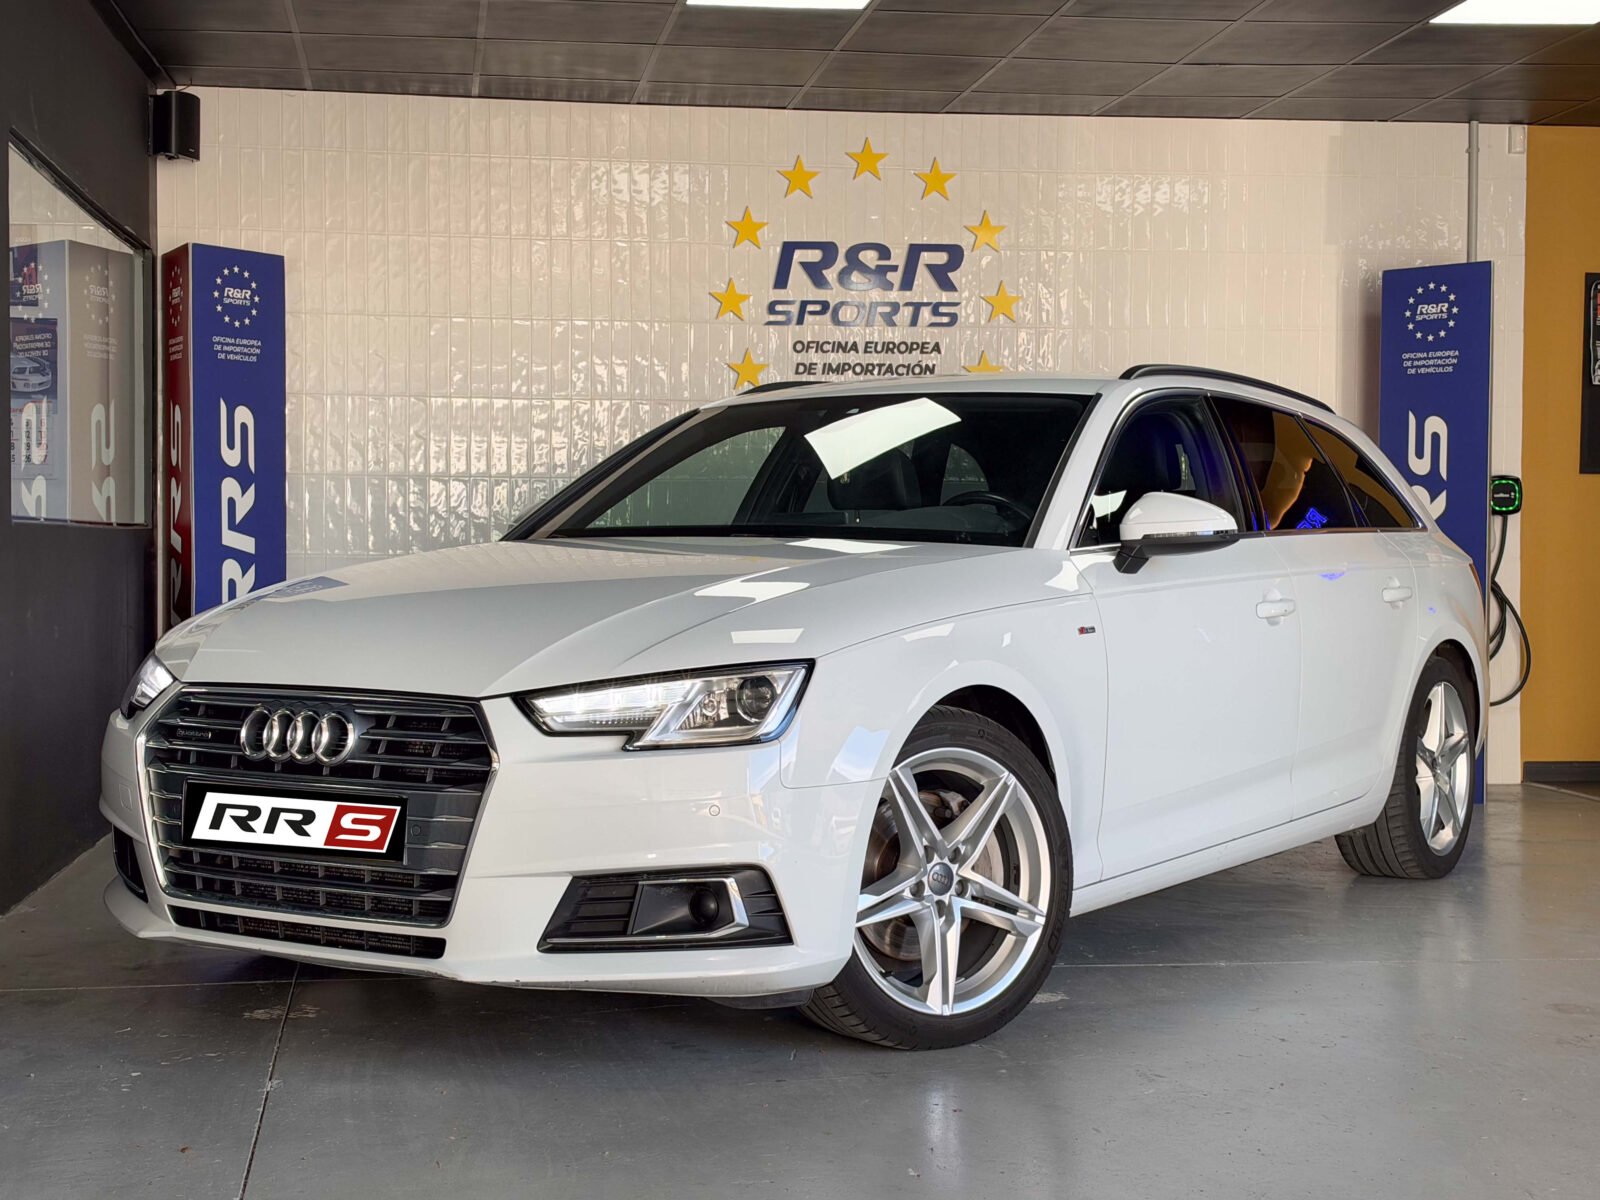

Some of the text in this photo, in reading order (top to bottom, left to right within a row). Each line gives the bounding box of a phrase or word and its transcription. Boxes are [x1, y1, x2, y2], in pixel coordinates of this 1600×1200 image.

[772, 241, 965, 292] R&R
[224, 287, 252, 299] R&R
[223, 297, 251, 306] SPORTS
[764, 299, 962, 327] SPORTS
[1417, 303, 1448, 314] R&R
[223, 345, 260, 354] IMPORTACIÓN
[792, 340, 942, 355] OFICINA EUROPEA
[1402, 352, 1427, 360] OFICINA
[1413, 357, 1458, 367] IMPORTACIÓN
[794, 360, 937, 377] DE IMPORTACIÓN
[208, 802, 388, 842] RRS
